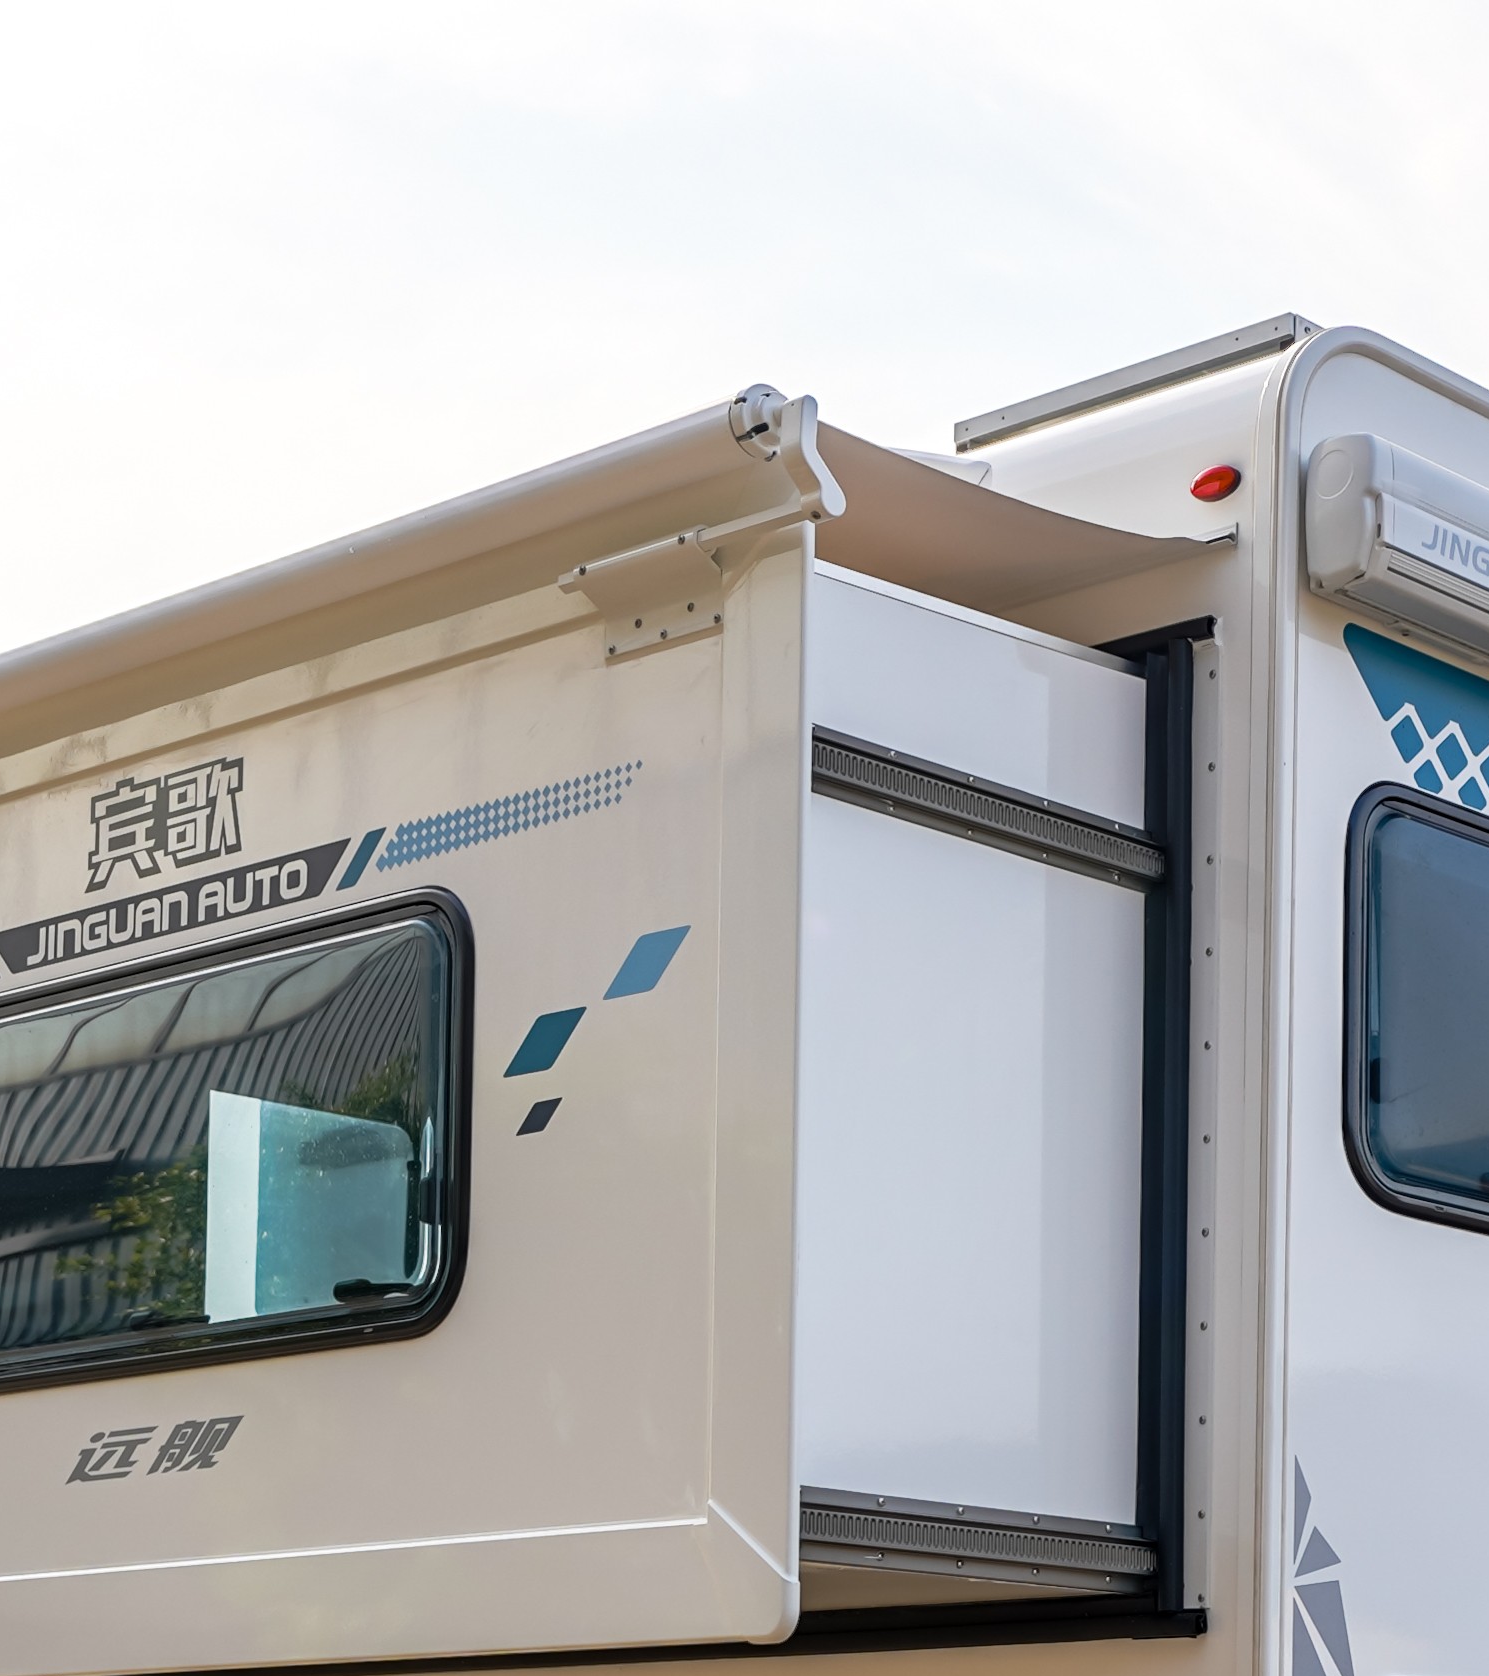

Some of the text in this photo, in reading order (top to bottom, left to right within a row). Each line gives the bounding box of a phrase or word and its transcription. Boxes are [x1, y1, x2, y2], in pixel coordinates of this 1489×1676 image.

[85, 756, 244, 894] 宾歌
[25, 860, 308, 967] JINGUAN AUTO
[65, 1414, 245, 1486] 远舰
